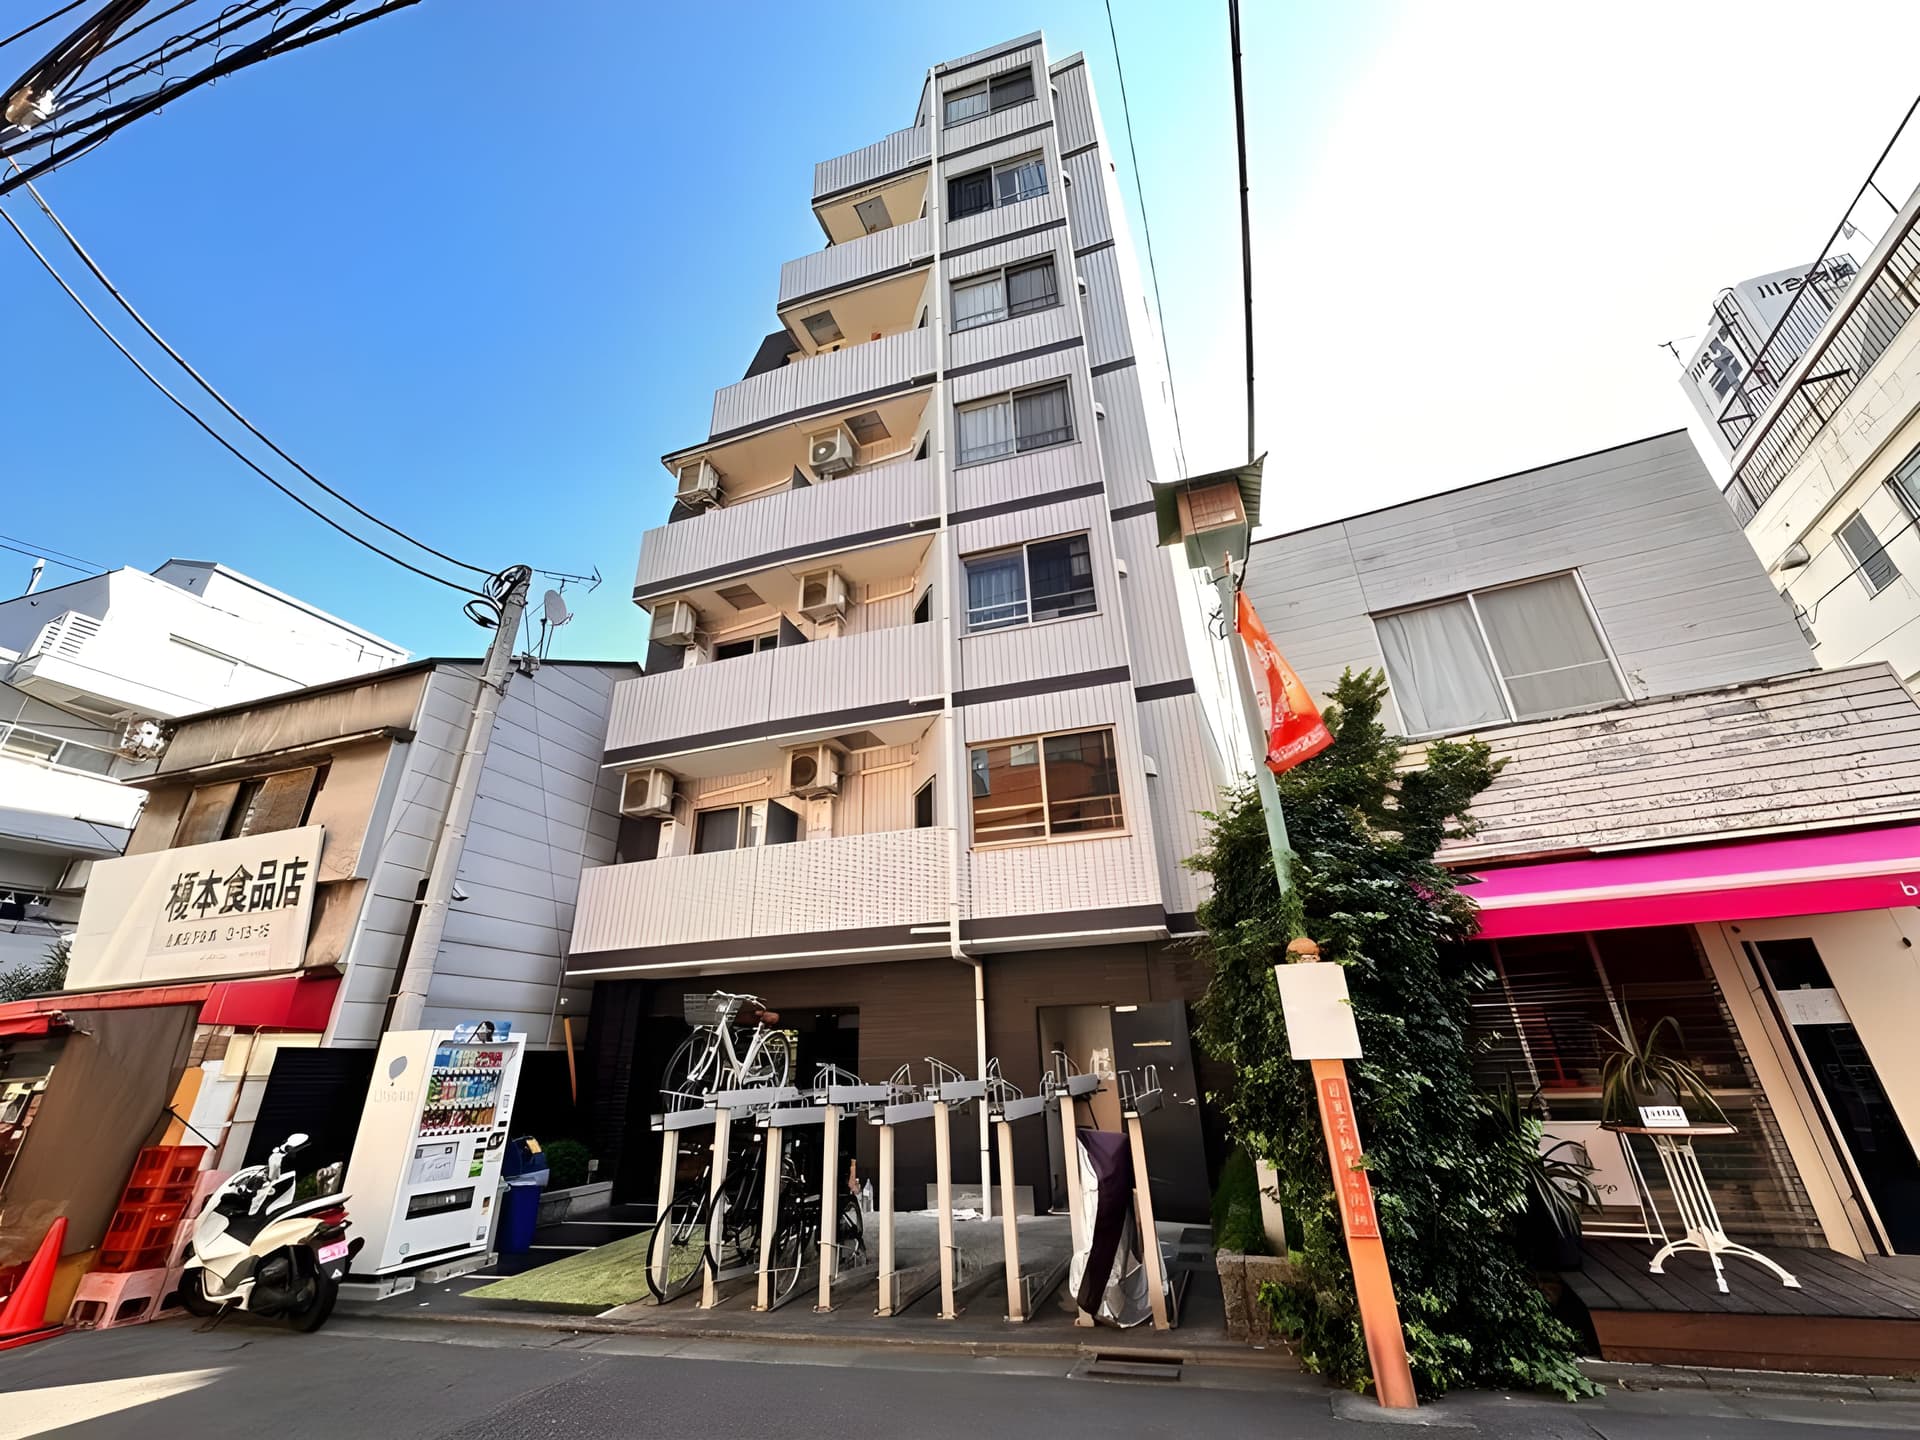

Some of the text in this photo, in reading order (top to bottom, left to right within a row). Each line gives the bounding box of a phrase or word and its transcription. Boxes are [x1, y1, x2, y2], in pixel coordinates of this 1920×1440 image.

[165, 856, 308, 922] 榎本食品店
